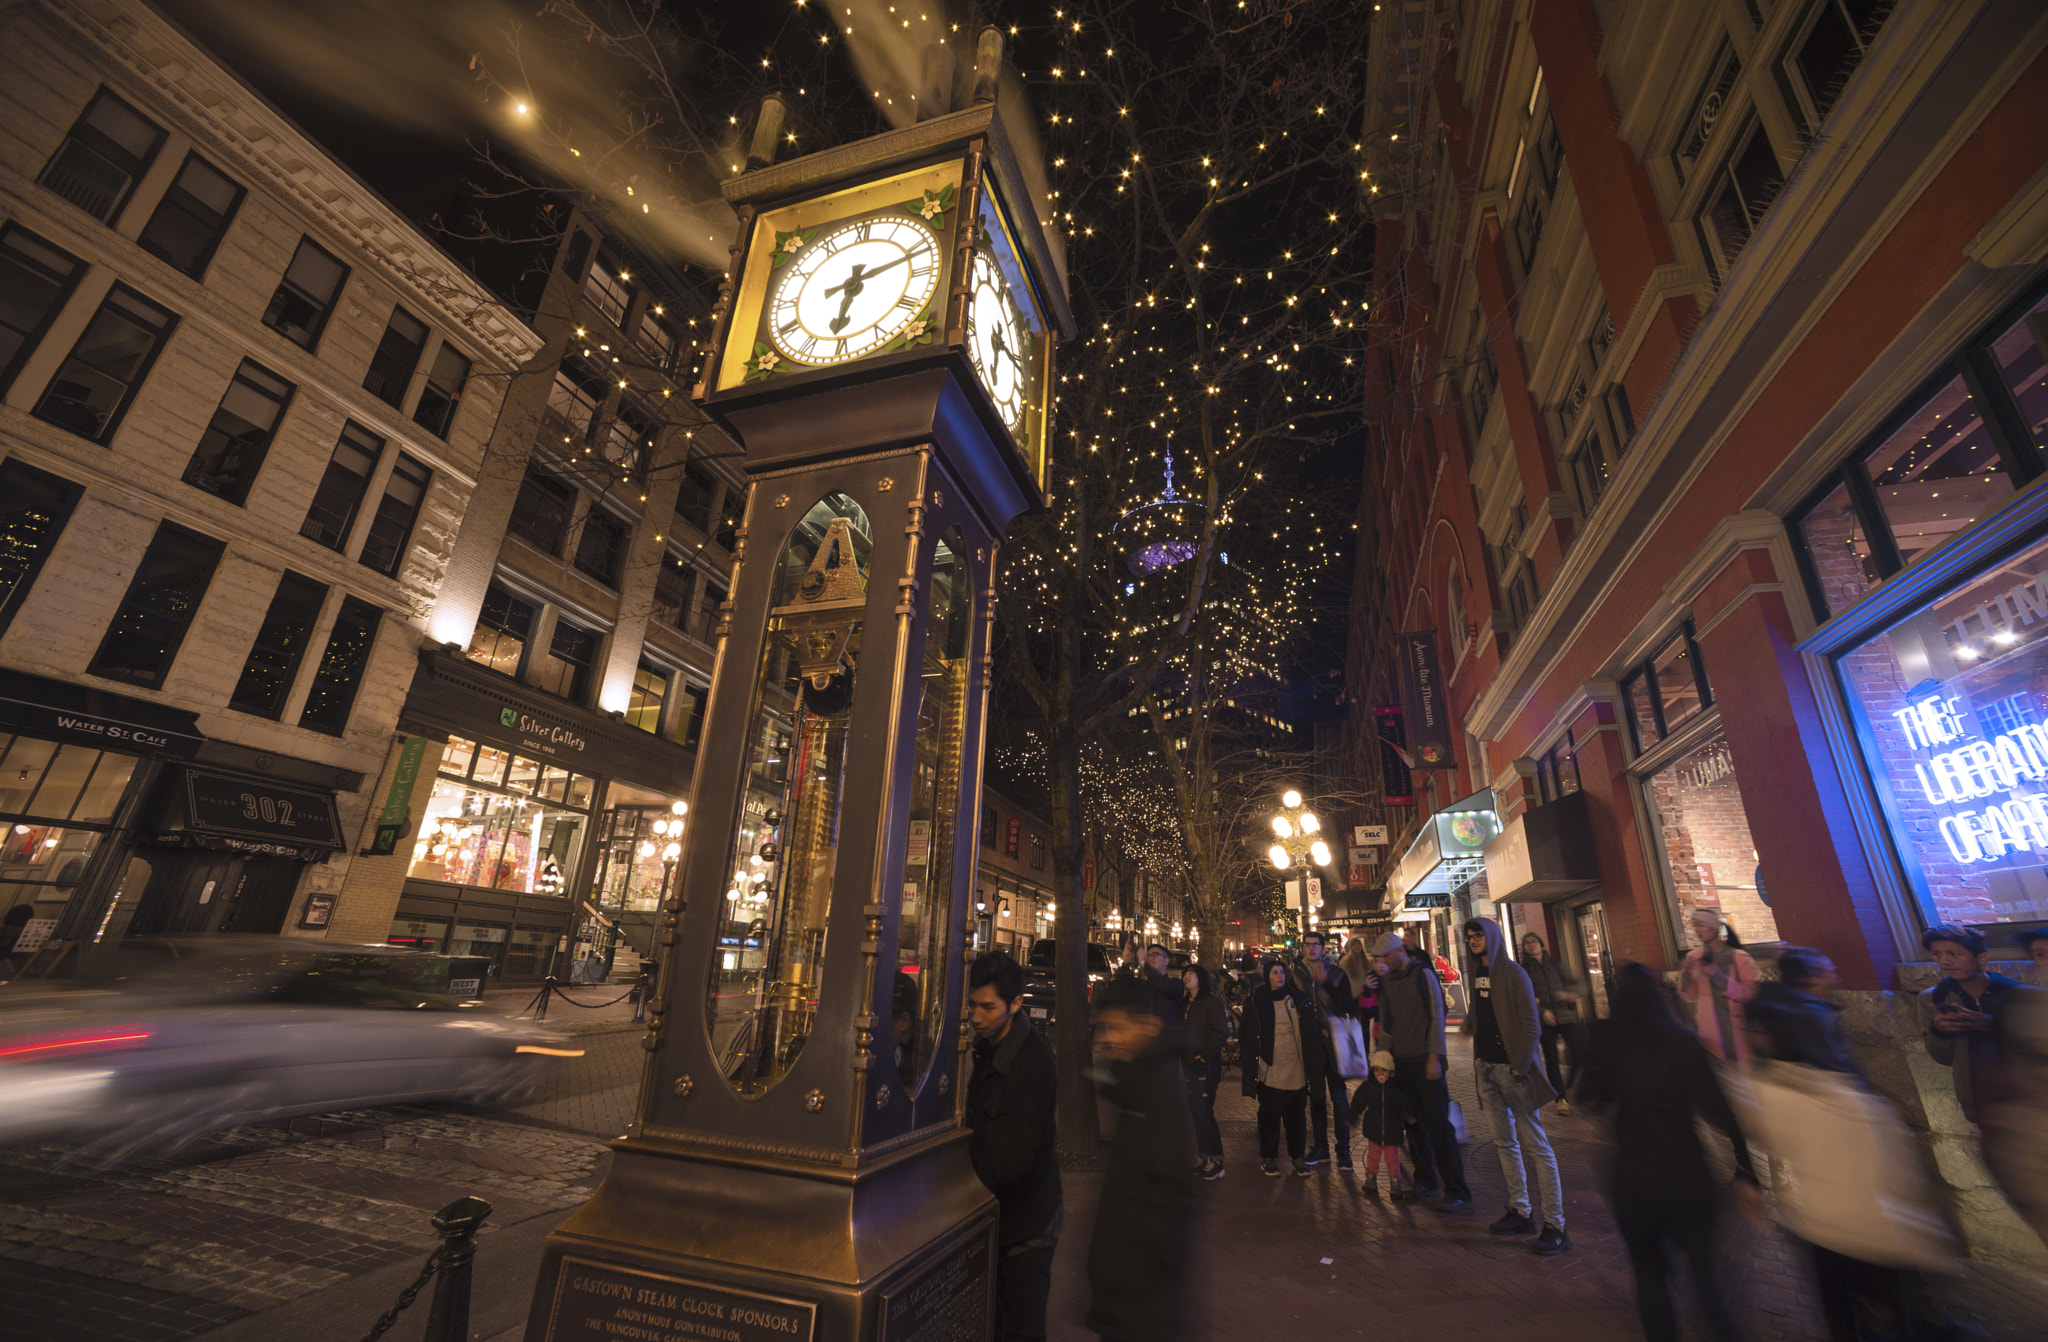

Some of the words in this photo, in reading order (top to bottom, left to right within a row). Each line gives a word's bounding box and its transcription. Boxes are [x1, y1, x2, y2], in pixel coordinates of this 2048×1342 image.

[519, 715, 550, 736] Silver
[552, 727, 585, 752] Gallery
[523, 740, 541, 750] SINCE
[398, 743, 421, 785] Gallery
[199, 796, 237, 807] WATER
[240, 793, 297, 827] 302
[297, 812, 330, 823] STREET
[1364, 831, 1381, 839] SELC
[234, 874, 248, 898] 302
[452, 980, 475, 988] WEST
[573, 1277, 633, 1301] GASTOWN
[636, 1288, 677, 1310] STEAM
[682, 1297, 725, 1320] CLOCK
[730, 1307, 799, 1335] SPONSORS
[584, 1318, 602, 1331] THE
[605, 1321, 661, 1342] VANCOUVER
[614, 1308, 671, 1329] ANONYMOUS
[674, 1319, 743, 1342] CONTRIBUTOR
